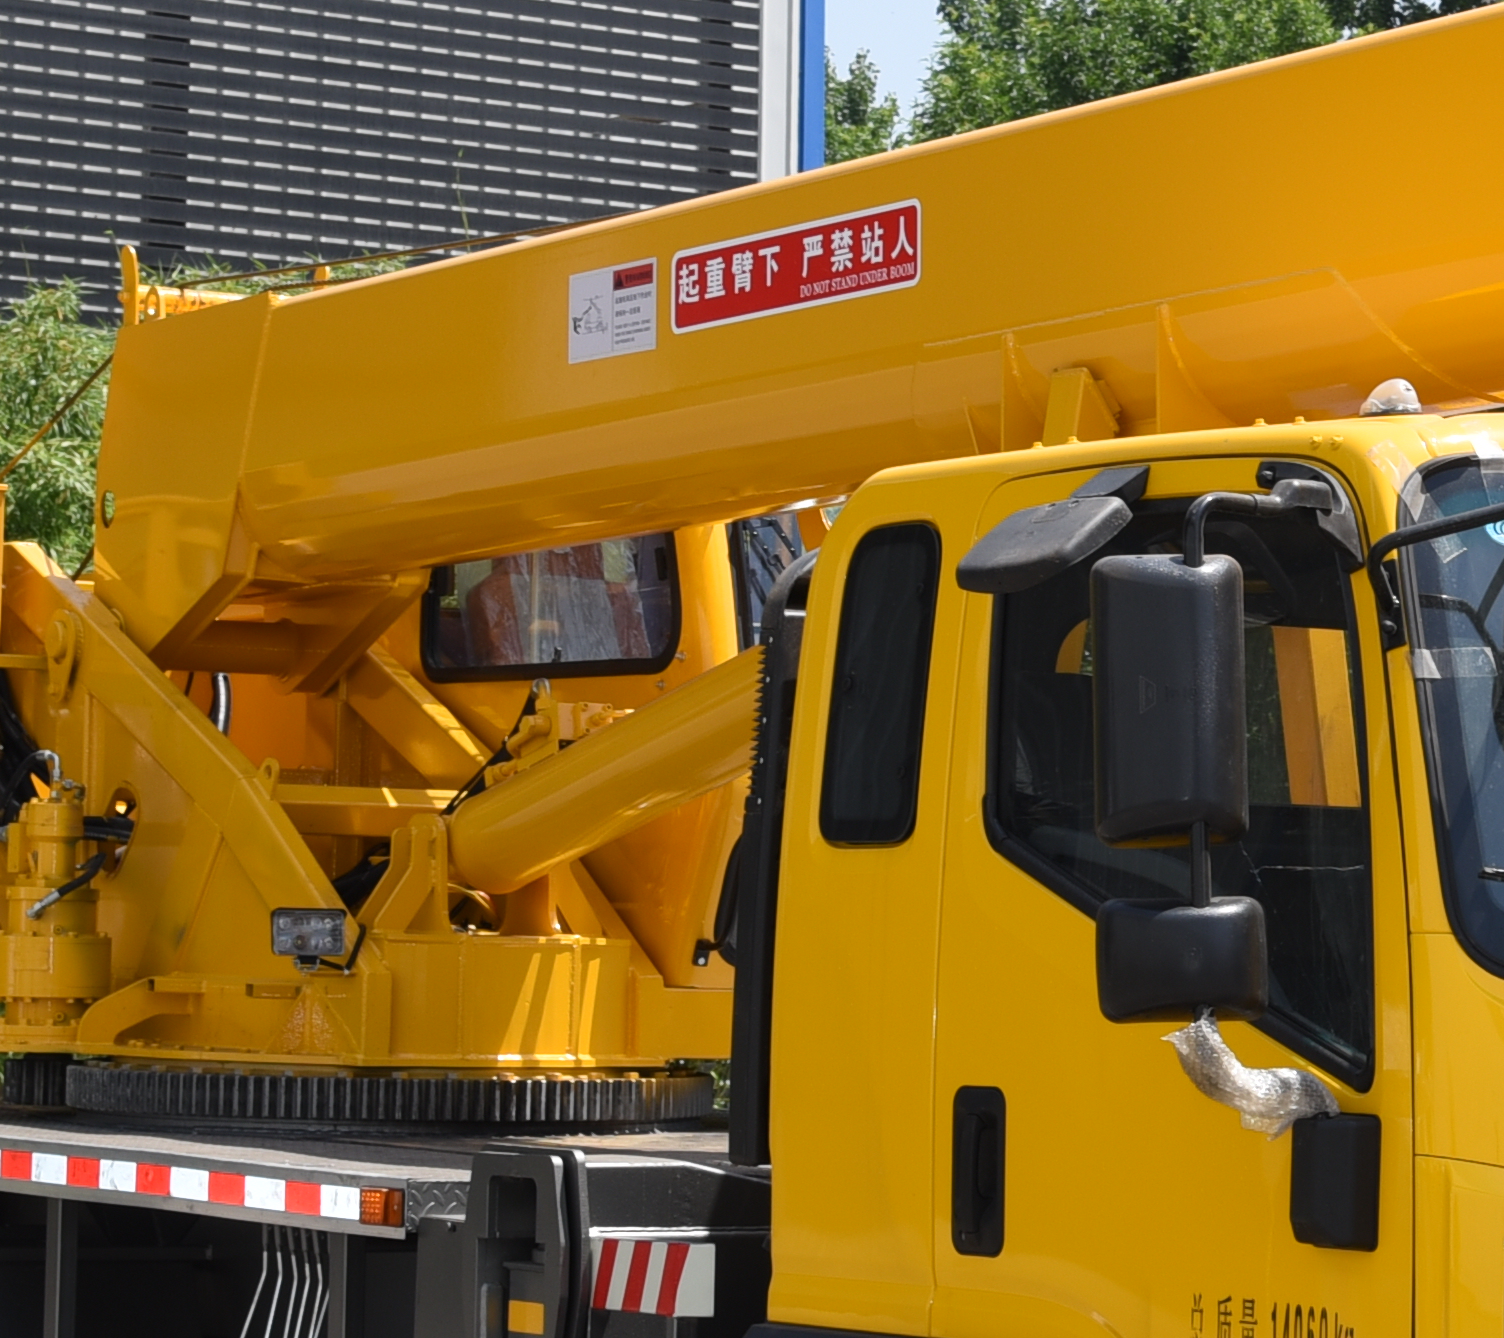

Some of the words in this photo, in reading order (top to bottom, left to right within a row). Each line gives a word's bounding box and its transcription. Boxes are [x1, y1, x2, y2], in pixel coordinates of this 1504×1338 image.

[677, 244, 781, 305] 起重臂下
[801, 215, 915, 279] 严禁站人
[799, 283, 813, 298] DO
[813, 279, 830, 296] NOT
[830, 274, 859, 292] STAND
[859, 267, 889, 286] UNDER
[889, 261, 915, 279] BOOM
